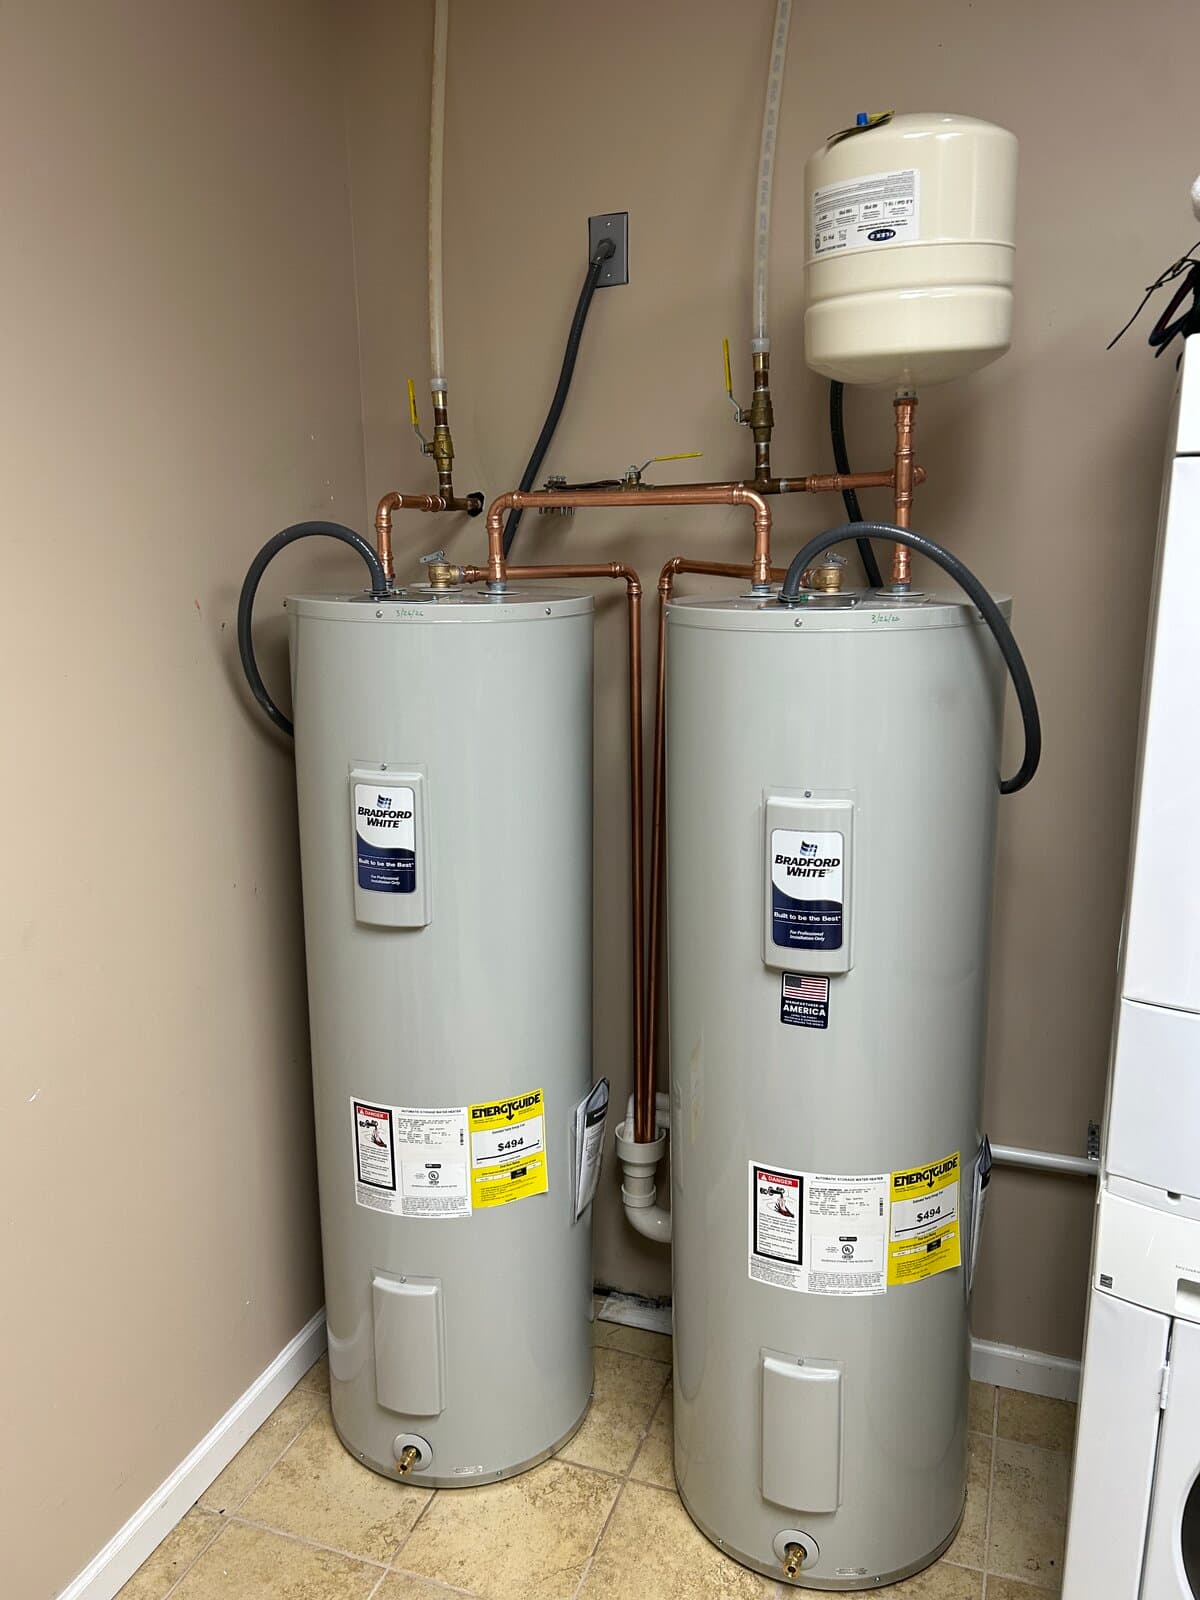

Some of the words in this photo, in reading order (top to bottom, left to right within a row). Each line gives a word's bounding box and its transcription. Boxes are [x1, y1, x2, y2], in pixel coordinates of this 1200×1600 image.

[358, 806, 412, 819] BRADFORD
[366, 817, 400, 828] WHITE
[775, 854, 841, 868] BRADFORD
[786, 866, 826, 878] WHITE
[774, 911, 789, 920] Built
[783, 1004, 826, 1016] AMERICA
[472, 1093, 541, 1120] ENERGYGUIDE
[364, 1110, 385, 1118] DANGER
[497, 1137, 524, 1152] $494
[893, 1156, 958, 1188] ENERGYGUIDE
[768, 1176, 793, 1186] DANGER
[916, 1206, 941, 1223] $494
